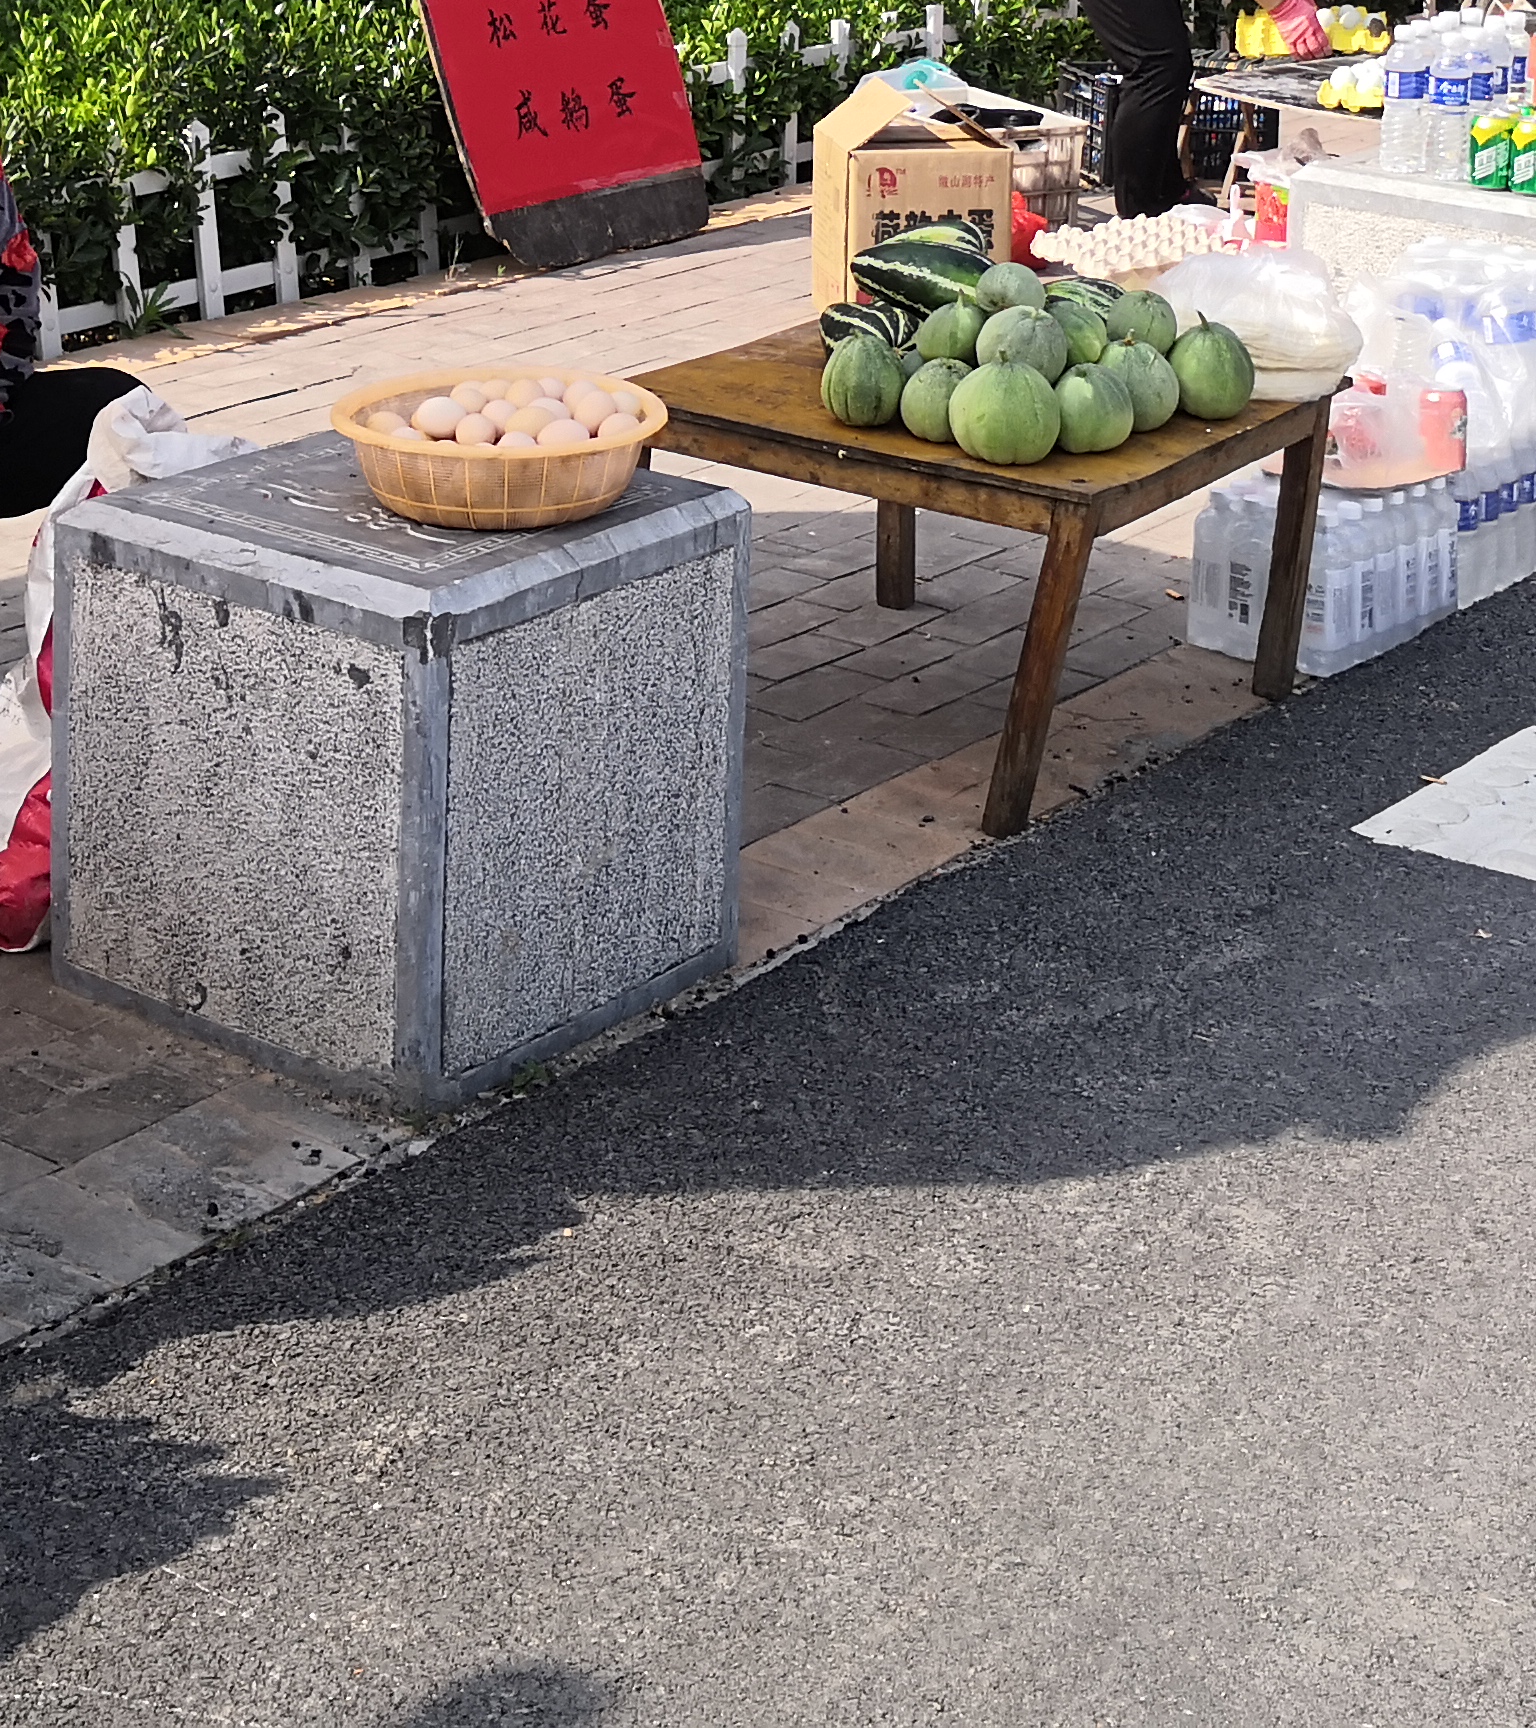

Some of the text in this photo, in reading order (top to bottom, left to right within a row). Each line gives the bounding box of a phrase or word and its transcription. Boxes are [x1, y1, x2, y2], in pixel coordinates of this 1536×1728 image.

[515, 76, 637, 141] 咸鹅蛋
[938, 175, 995, 188] 微山湖特产
